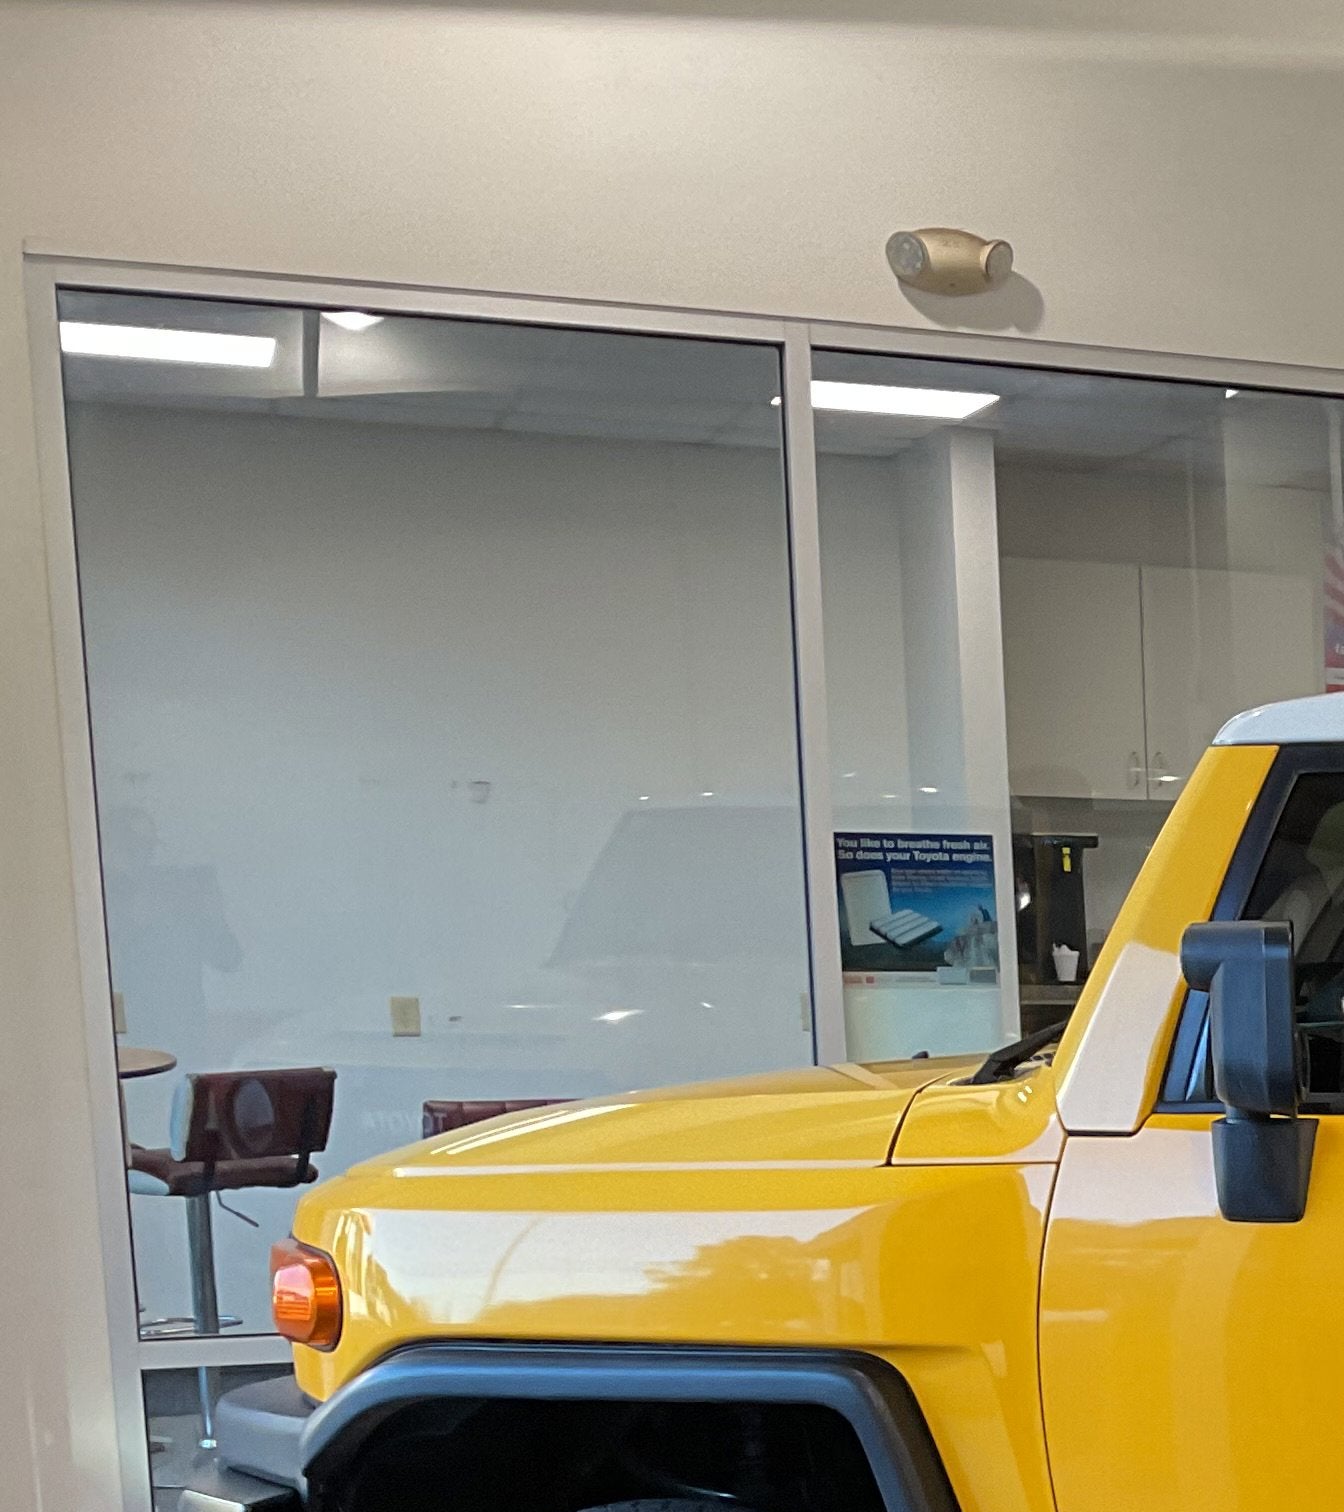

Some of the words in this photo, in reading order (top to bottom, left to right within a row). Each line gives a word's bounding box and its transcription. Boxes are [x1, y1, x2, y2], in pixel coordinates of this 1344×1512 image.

[836, 838, 858, 848] You
[860, 838, 881, 848] like
[883, 839, 895, 848] to
[897, 839, 941, 849] breathe
[942, 840, 971, 850] fresh
[837, 850, 854, 860] So
[855, 850, 884, 860] does
[885, 852, 911, 862] your
[912, 851, 950, 863] Toyota
[951, 852, 992, 863] engine.
